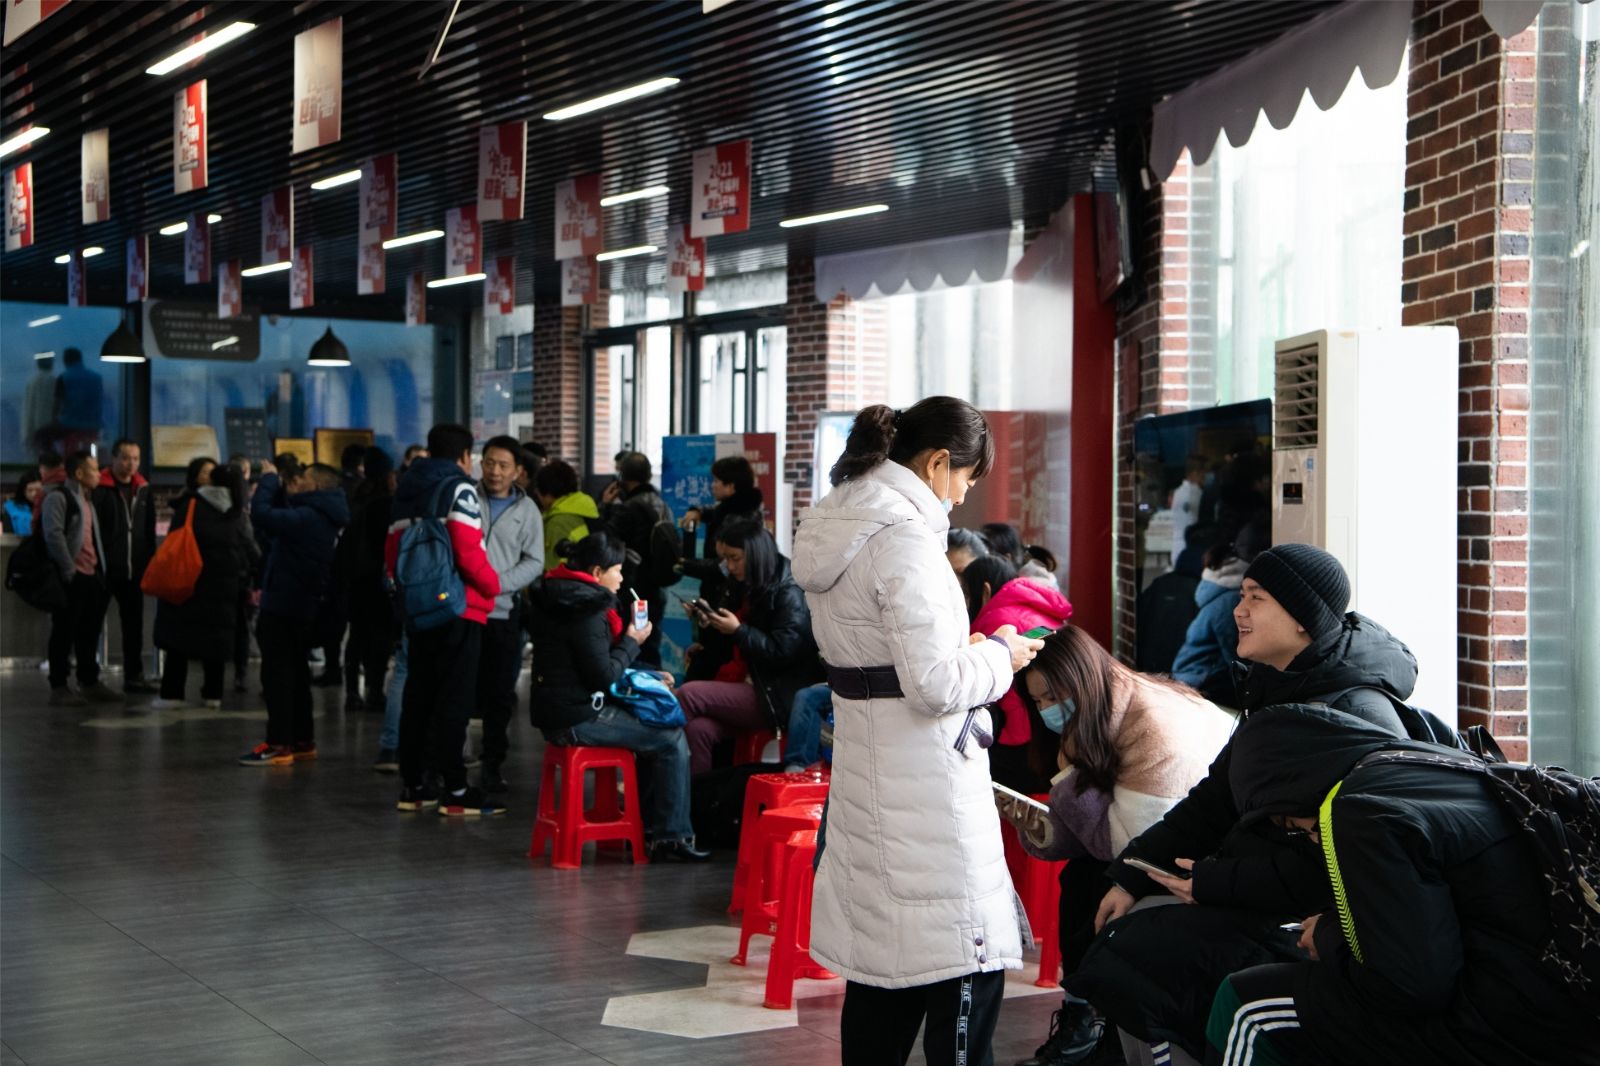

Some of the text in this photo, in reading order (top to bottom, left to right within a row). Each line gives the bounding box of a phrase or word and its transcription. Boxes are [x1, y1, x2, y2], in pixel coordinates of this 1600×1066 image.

[963, 982, 971, 1002] NIKE
[958, 1015, 967, 1034] NIKE
[958, 1050, 966, 1066] NIK
